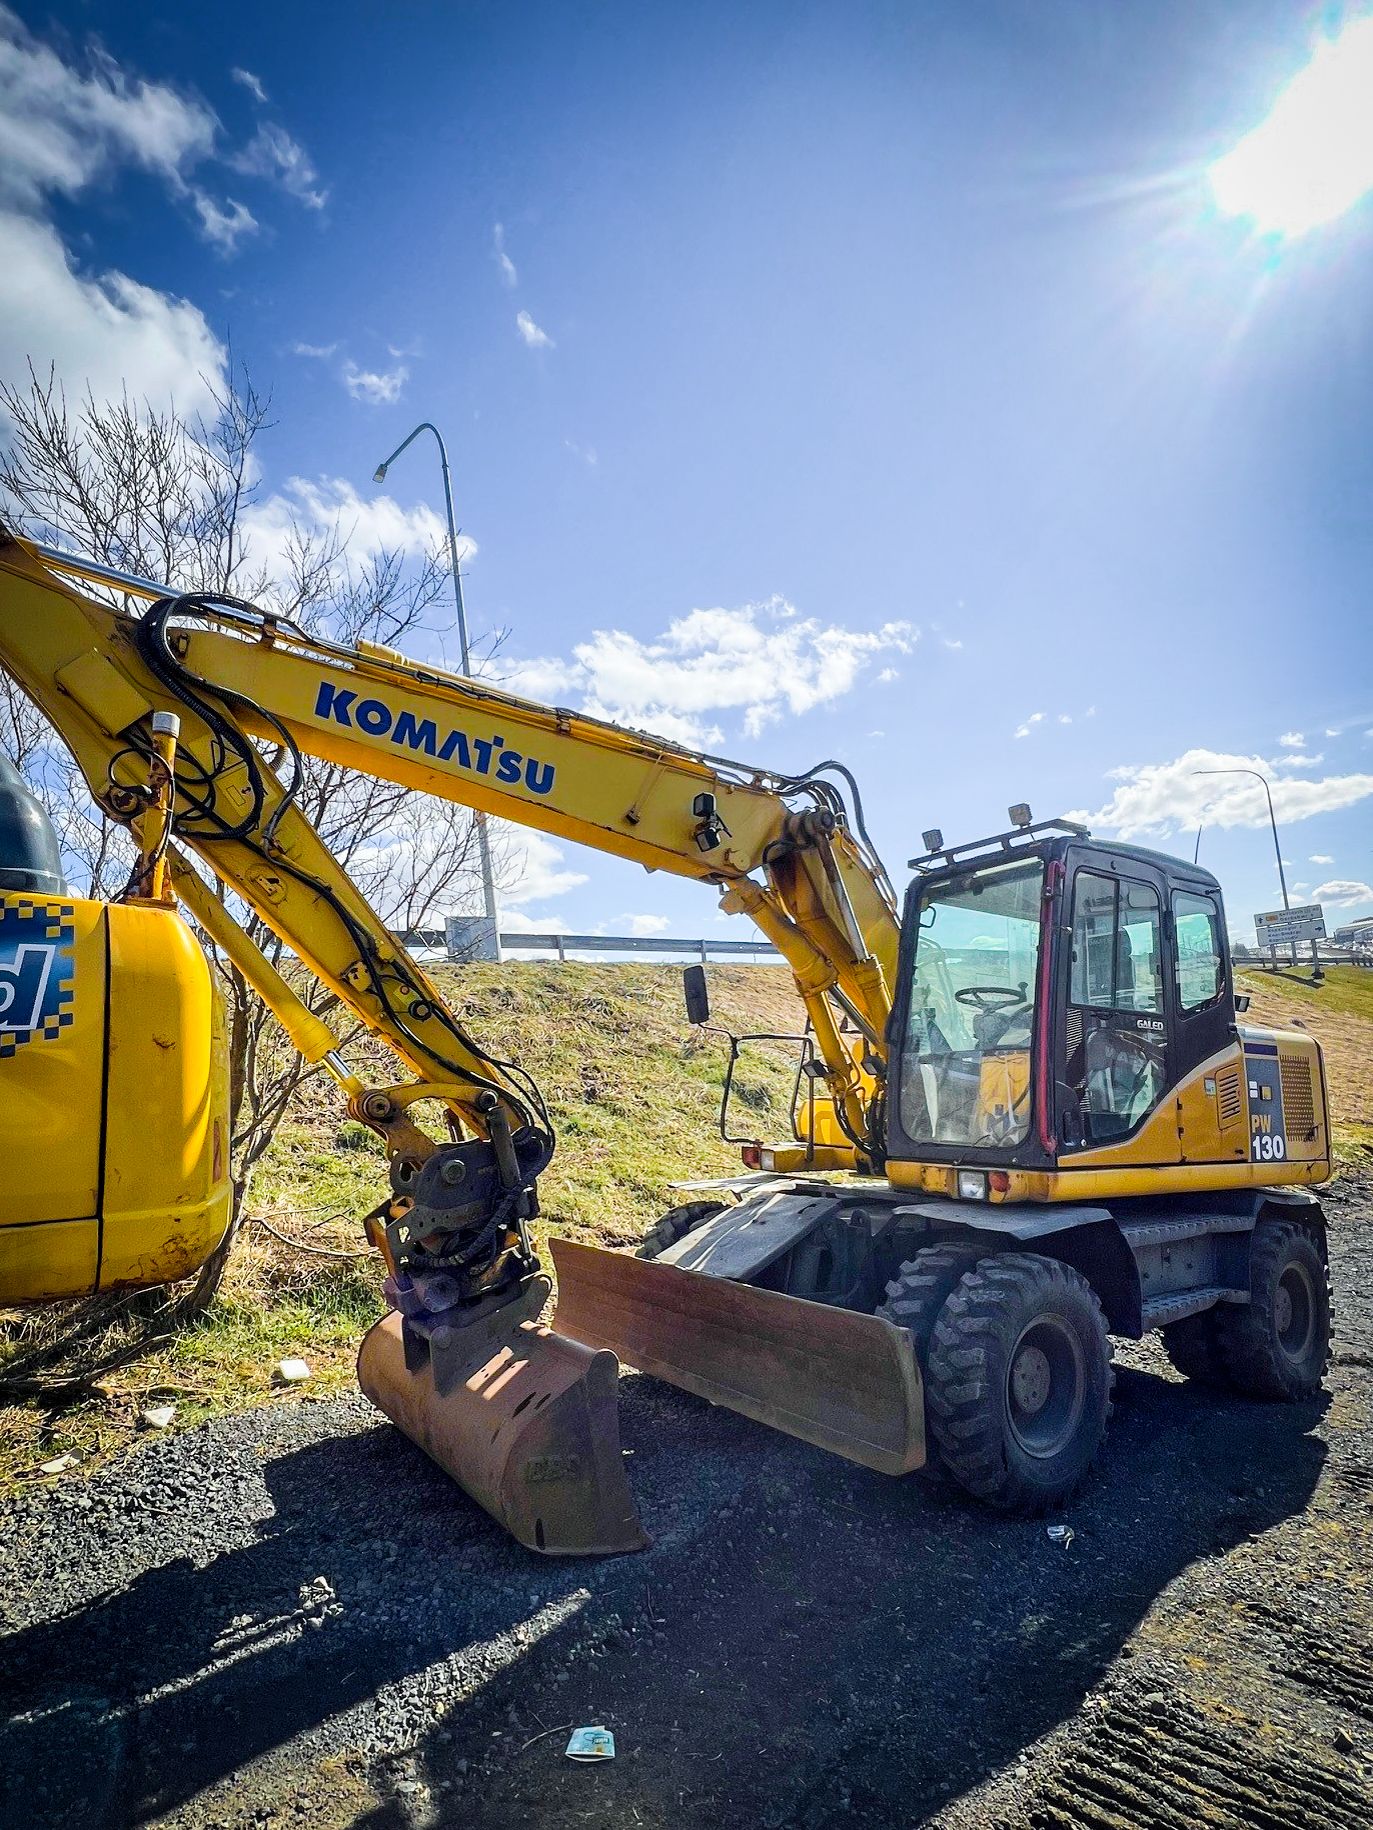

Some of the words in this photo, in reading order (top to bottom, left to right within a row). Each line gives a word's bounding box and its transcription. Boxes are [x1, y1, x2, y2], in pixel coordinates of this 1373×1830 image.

[314, 681, 556, 795] KOMATSU
[1251, 1114, 1272, 1133] PW
[1252, 1135, 1285, 1160] 130
